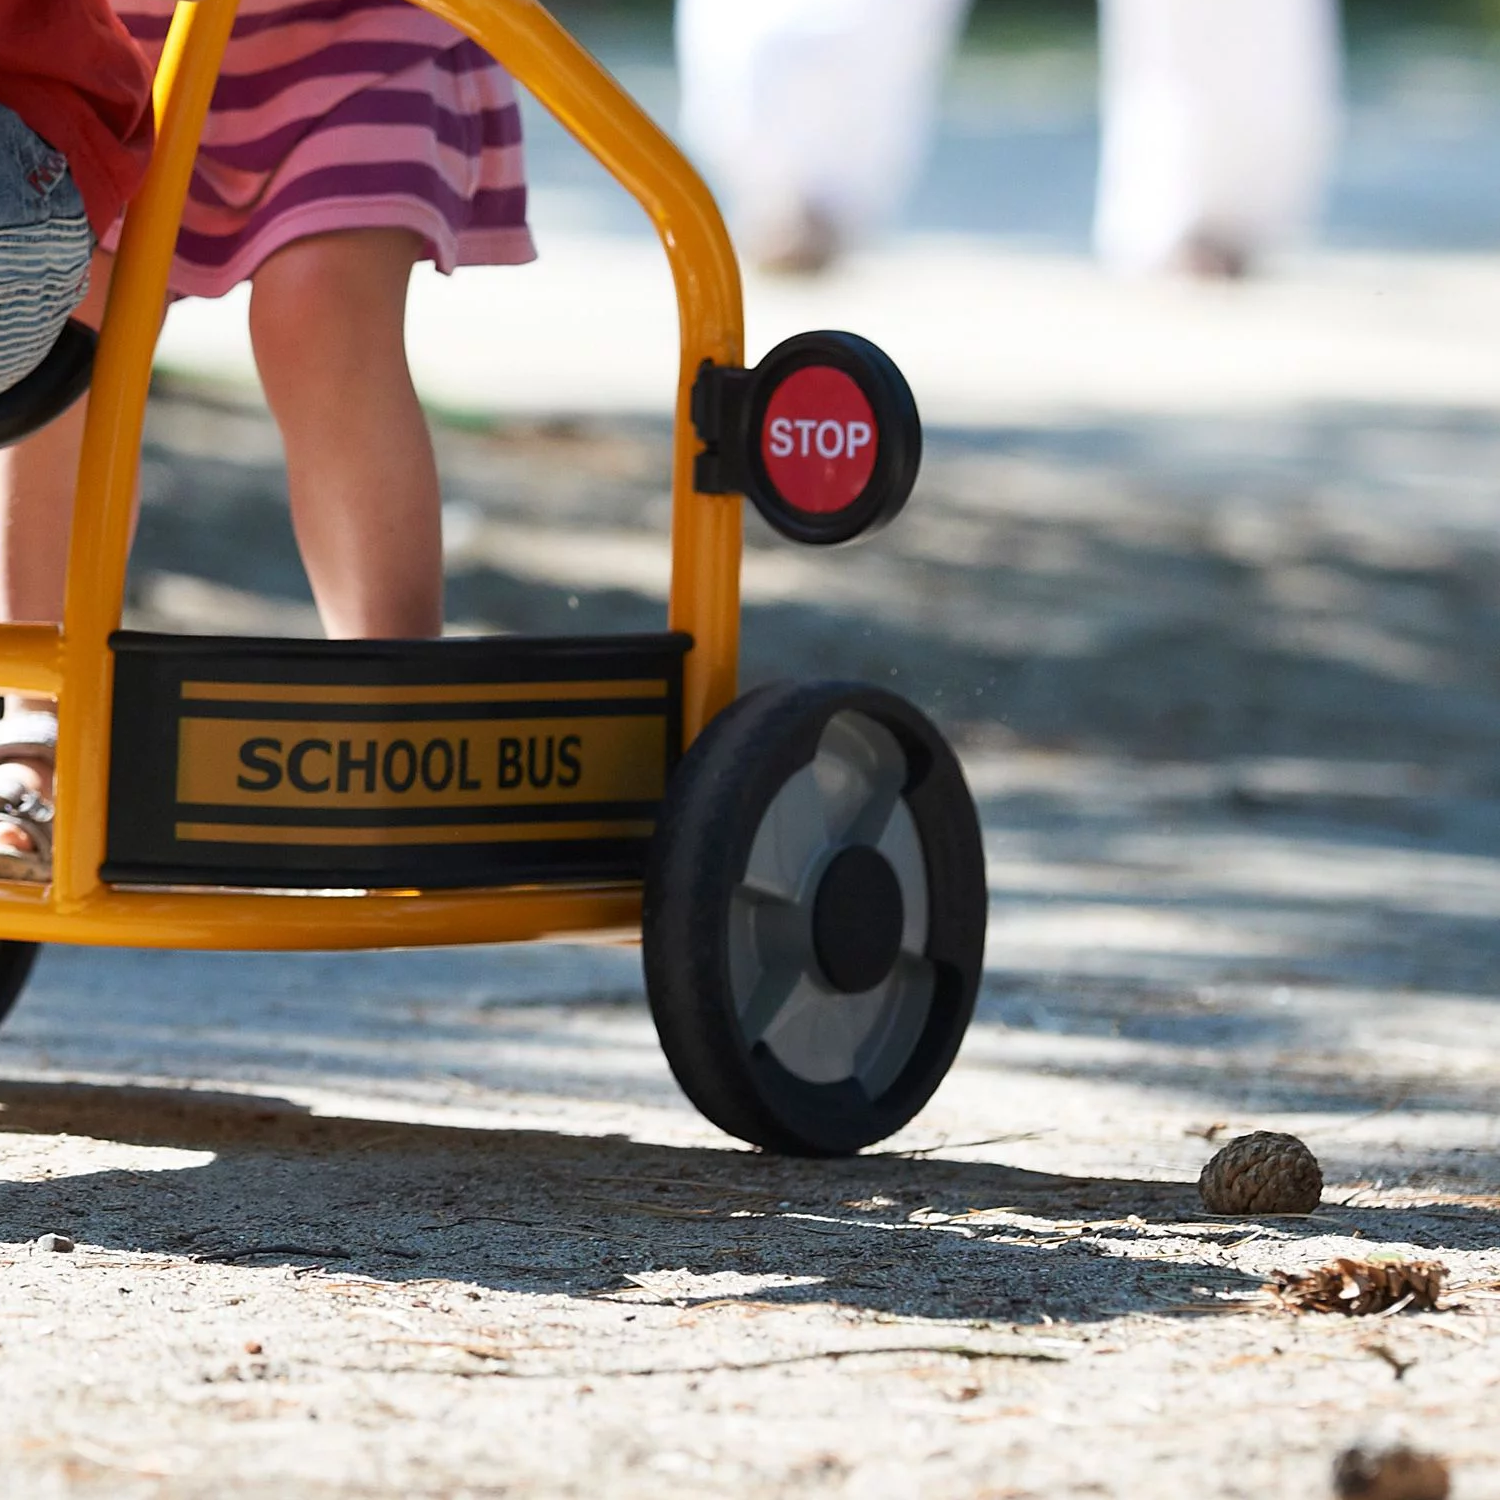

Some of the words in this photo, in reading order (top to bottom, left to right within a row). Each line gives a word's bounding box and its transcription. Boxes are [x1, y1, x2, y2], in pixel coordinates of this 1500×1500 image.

[769, 417, 871, 458] STOP
[236, 737, 481, 793] SCHOOL
[496, 734, 582, 790] BUS
